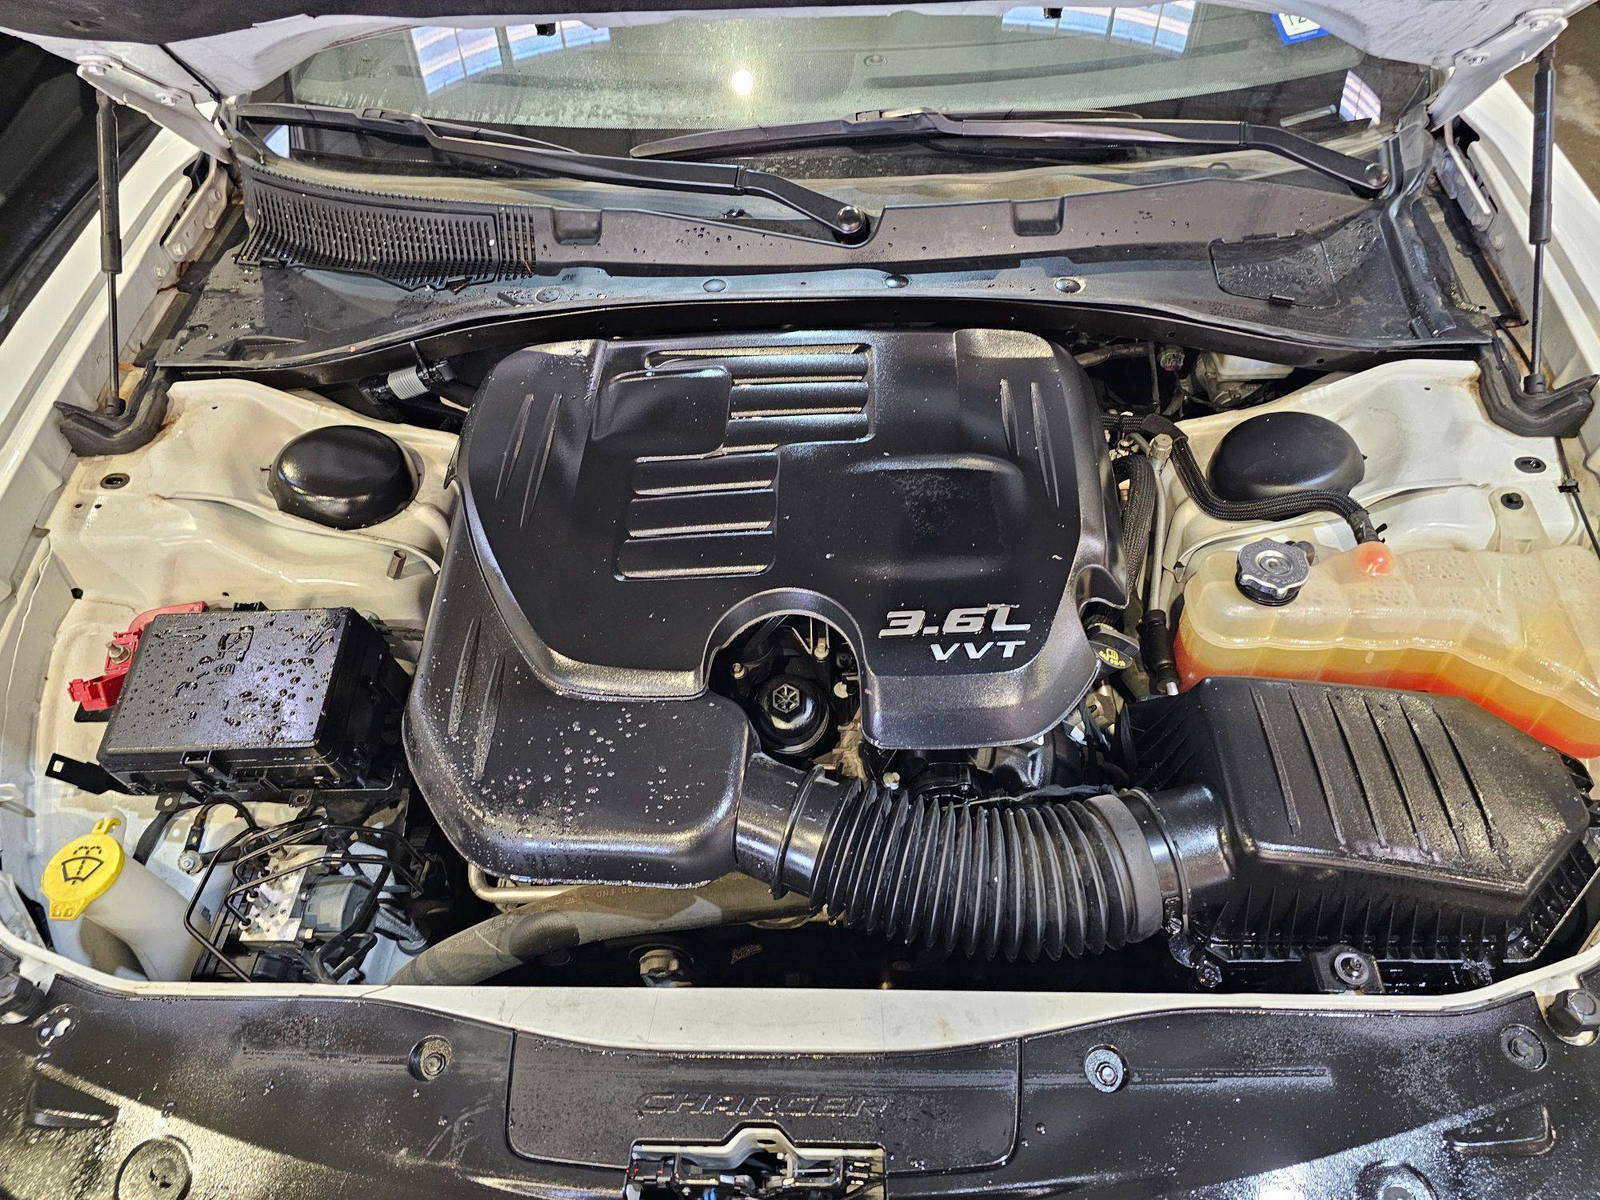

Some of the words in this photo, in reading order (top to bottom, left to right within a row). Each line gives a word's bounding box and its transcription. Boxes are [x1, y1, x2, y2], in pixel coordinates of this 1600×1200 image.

[878, 603, 1031, 638] 3.6L
[930, 640, 1026, 662] VVT
[639, 1092, 895, 1117] CHARGER
